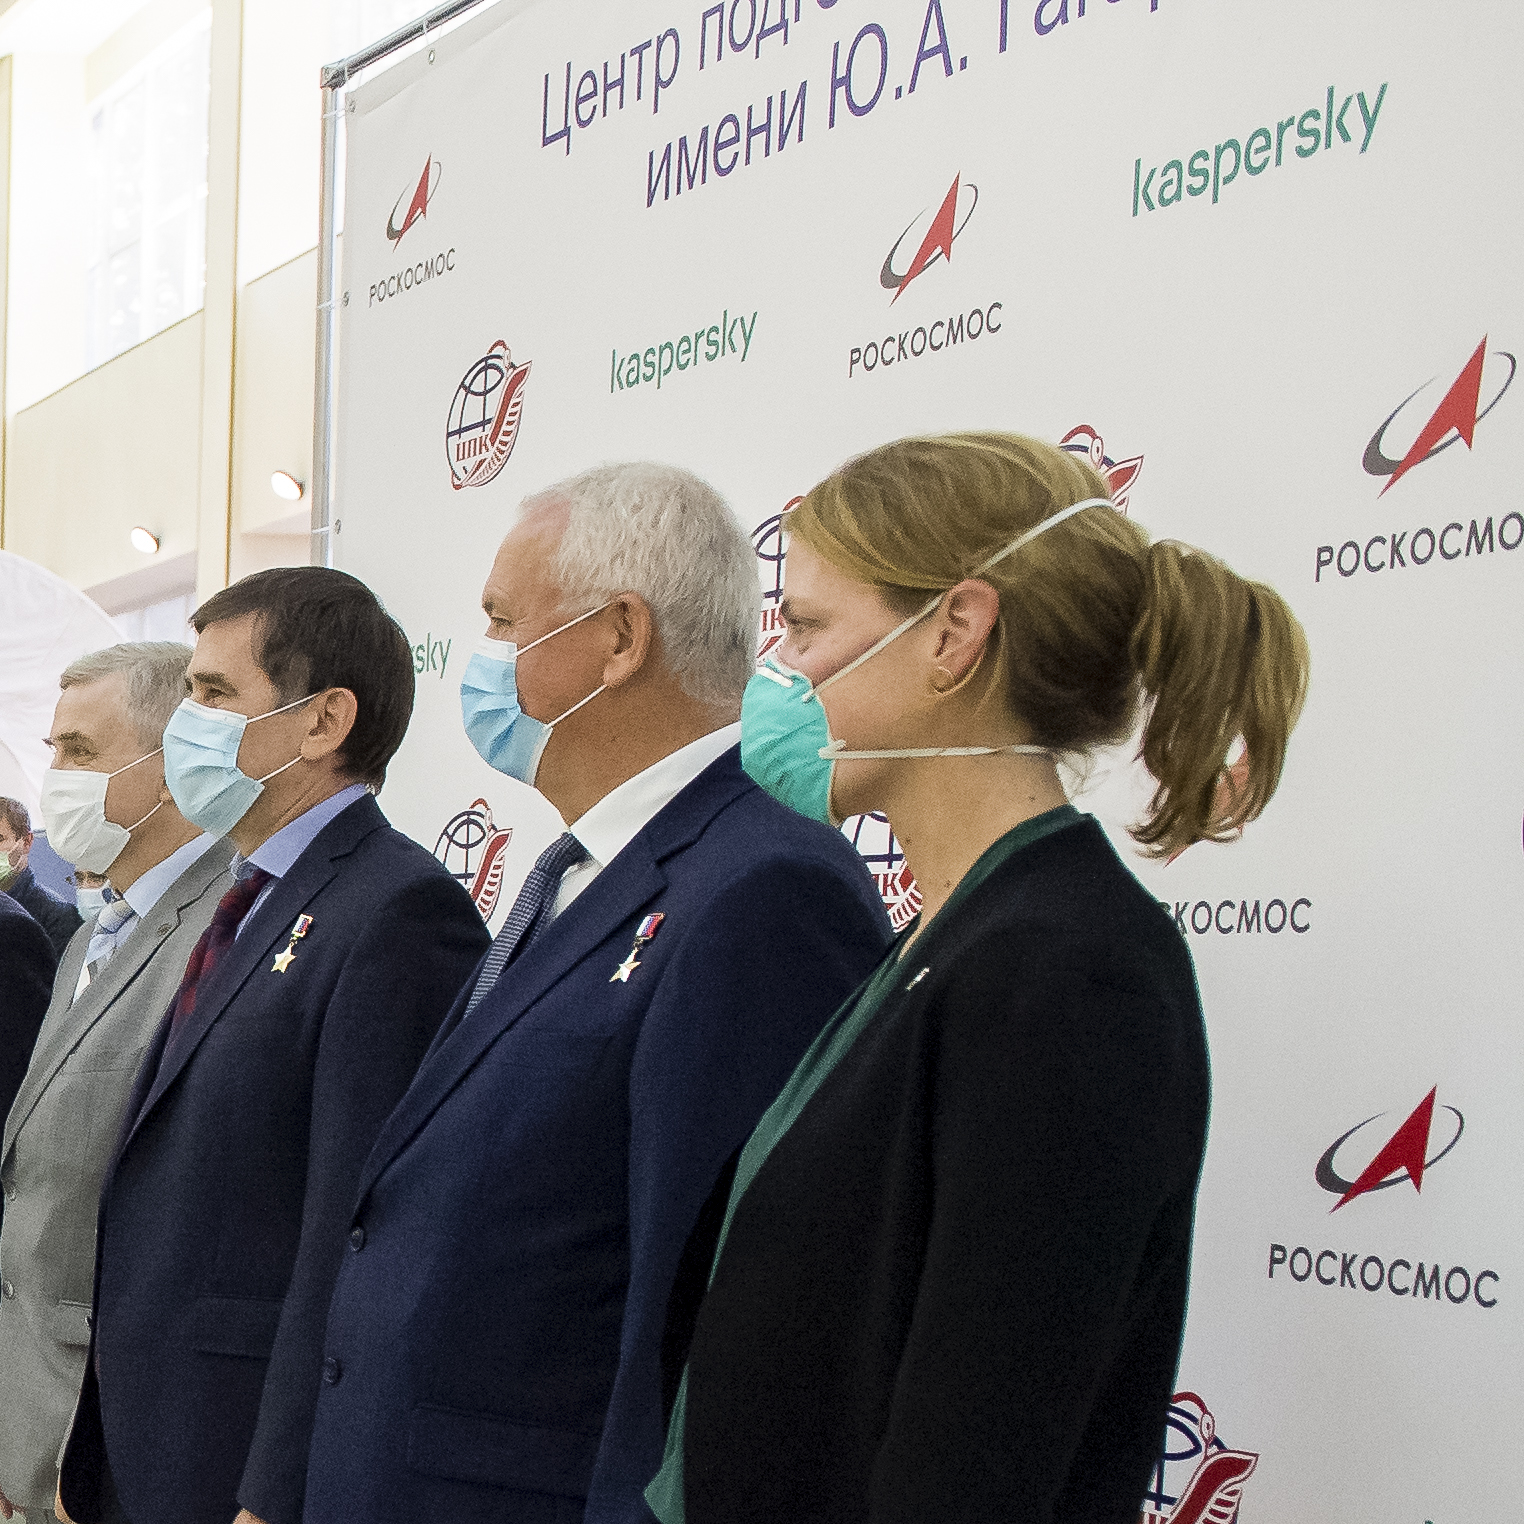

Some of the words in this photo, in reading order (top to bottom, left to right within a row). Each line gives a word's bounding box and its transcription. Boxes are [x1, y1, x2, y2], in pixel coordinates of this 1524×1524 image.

[542, 27, 681, 156] Центр
[646, 79, 808, 208] имени
[828, 0, 968, 129] Ю.А.
[1133, 83, 1389, 218] kaspersky
[368, 247, 457, 308] РОСКОСМОС
[610, 310, 758, 394] kaspersky
[848, 301, 1004, 379] РОСКОСМОС
[1314, 511, 1524, 583] РОСКОСМО
[1159, 898, 1313, 936] КОСМОС
[1268, 1243, 1501, 1309] РОСКОСМОС
